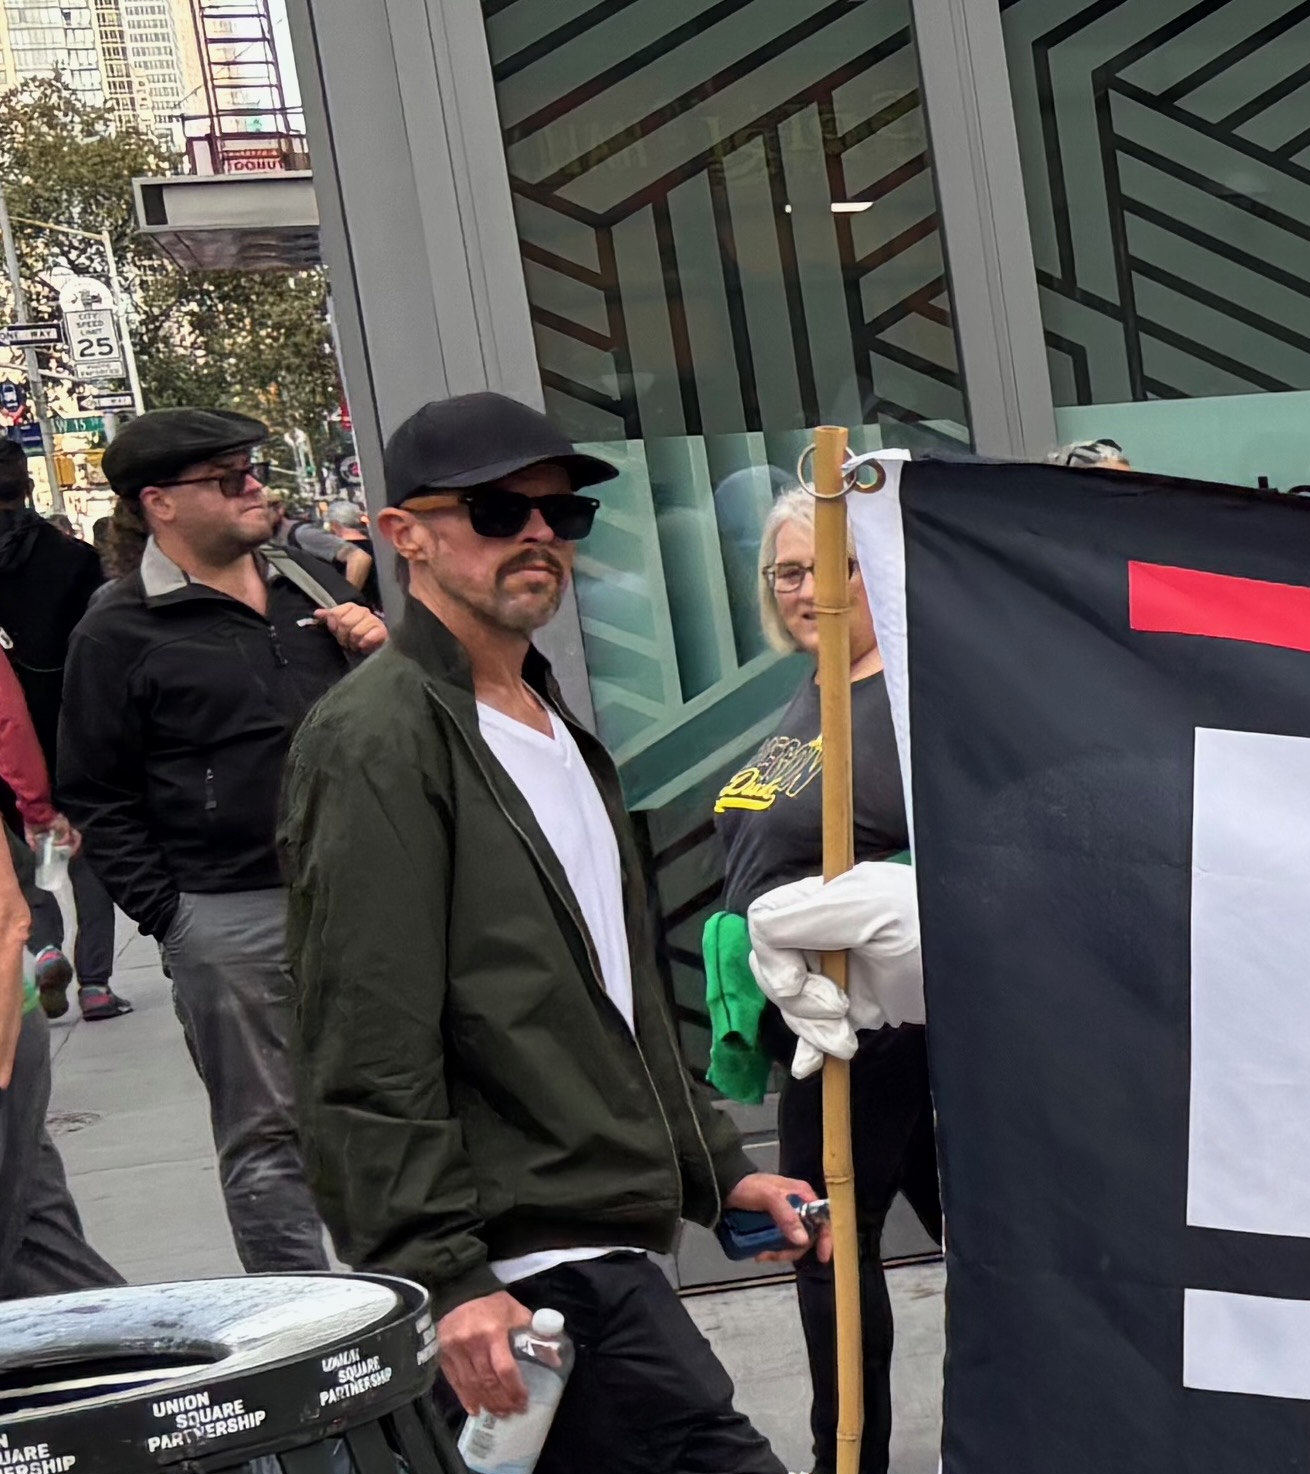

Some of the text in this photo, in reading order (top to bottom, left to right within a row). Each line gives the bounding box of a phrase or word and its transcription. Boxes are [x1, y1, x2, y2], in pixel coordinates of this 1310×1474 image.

[77, 337, 114, 358] 25
[74, 419, 86, 431] 15
[338, 1355, 381, 1383] SQUARE
[319, 1366, 393, 1407] PARTNERSHIP
[152, 1391, 211, 1418] UNION
[175, 1399, 245, 1429] SQUARE
[147, 1410, 267, 1453] PARTNERSHIP
